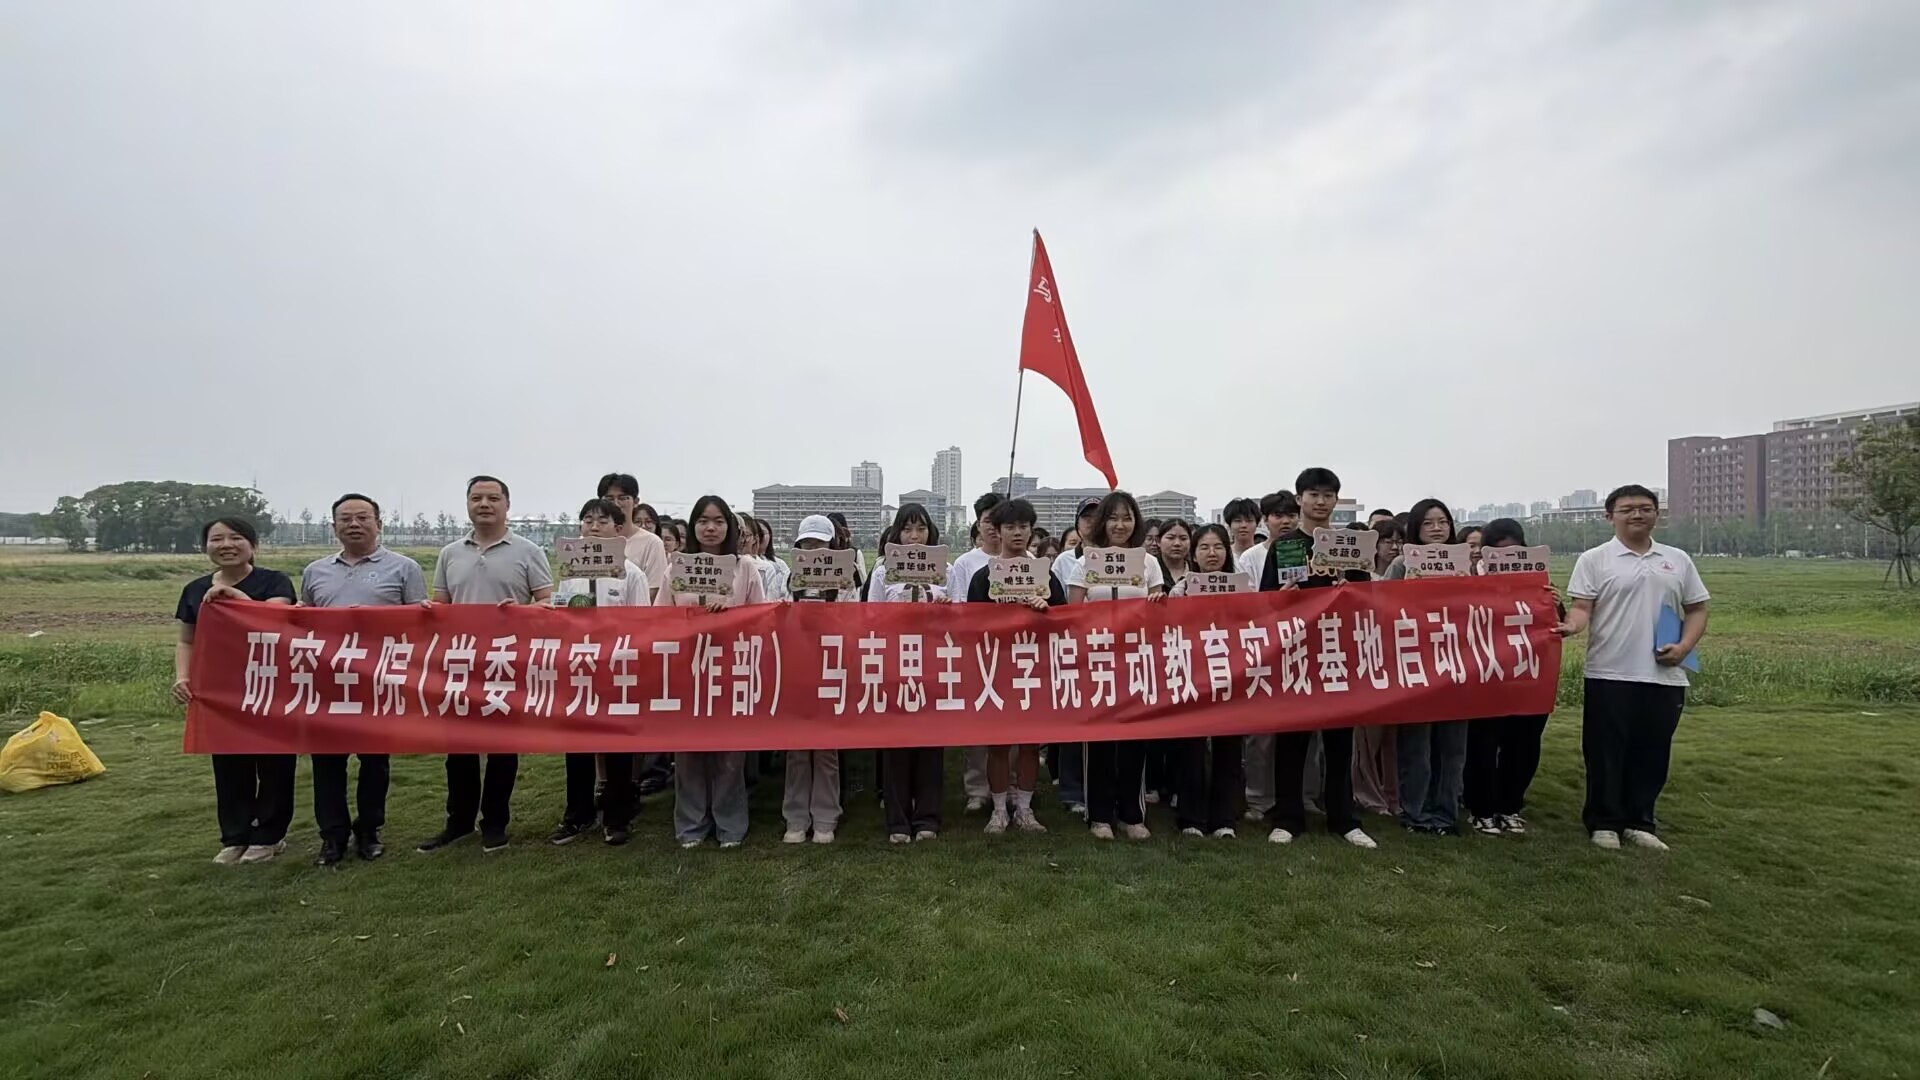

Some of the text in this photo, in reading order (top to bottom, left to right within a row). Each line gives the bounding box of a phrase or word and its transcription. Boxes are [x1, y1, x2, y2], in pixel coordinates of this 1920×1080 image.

[1336, 535, 1357, 545] 三组
[581, 544, 602, 552] 十组
[907, 551, 927, 560] 七组
[1104, 553, 1125, 562] 五组
[1427, 550, 1449, 559] 二组
[1505, 551, 1528, 559] 一组
[694, 557, 714, 565] 九组
[813, 556, 833, 565] 八组
[1009, 564, 1030, 573] 六组
[1420, 562, 1455, 571] QQ农场
[1208, 575, 1228, 583] 四组
[817, 600, 1541, 715] 马克思主义学院劳动教育实践基地启动仪式
